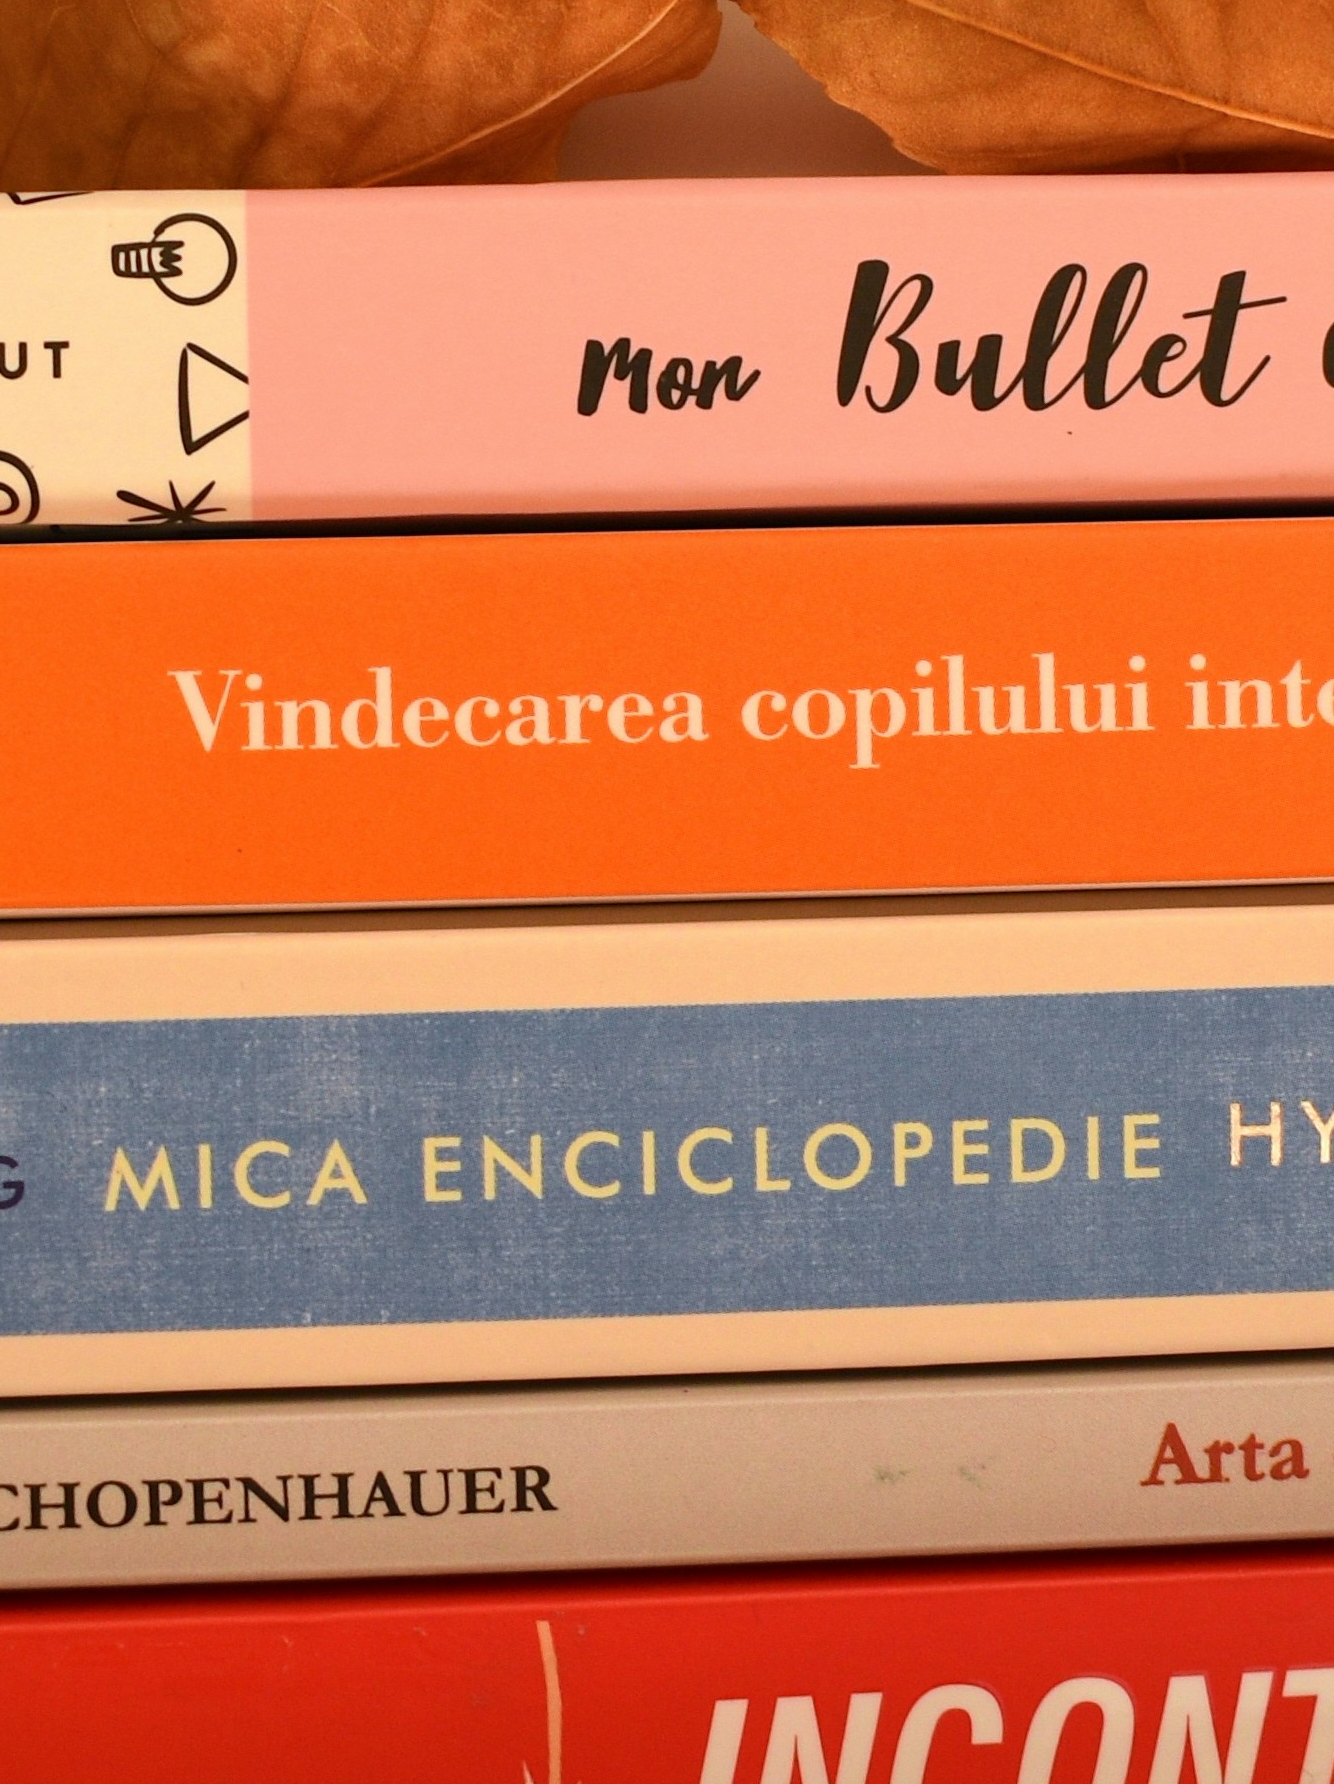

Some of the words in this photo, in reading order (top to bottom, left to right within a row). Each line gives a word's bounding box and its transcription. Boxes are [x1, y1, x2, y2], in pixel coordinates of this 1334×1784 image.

[837, 259, 1288, 413] Bullet
[167, 665, 710, 752] Vindecarea
[740, 651, 1155, 770] copilului
[103, 1138, 368, 1212] MICA
[422, 1113, 1161, 1203] ENCICLOPEDIE
[1139, 1422, 1311, 1488] Arta
